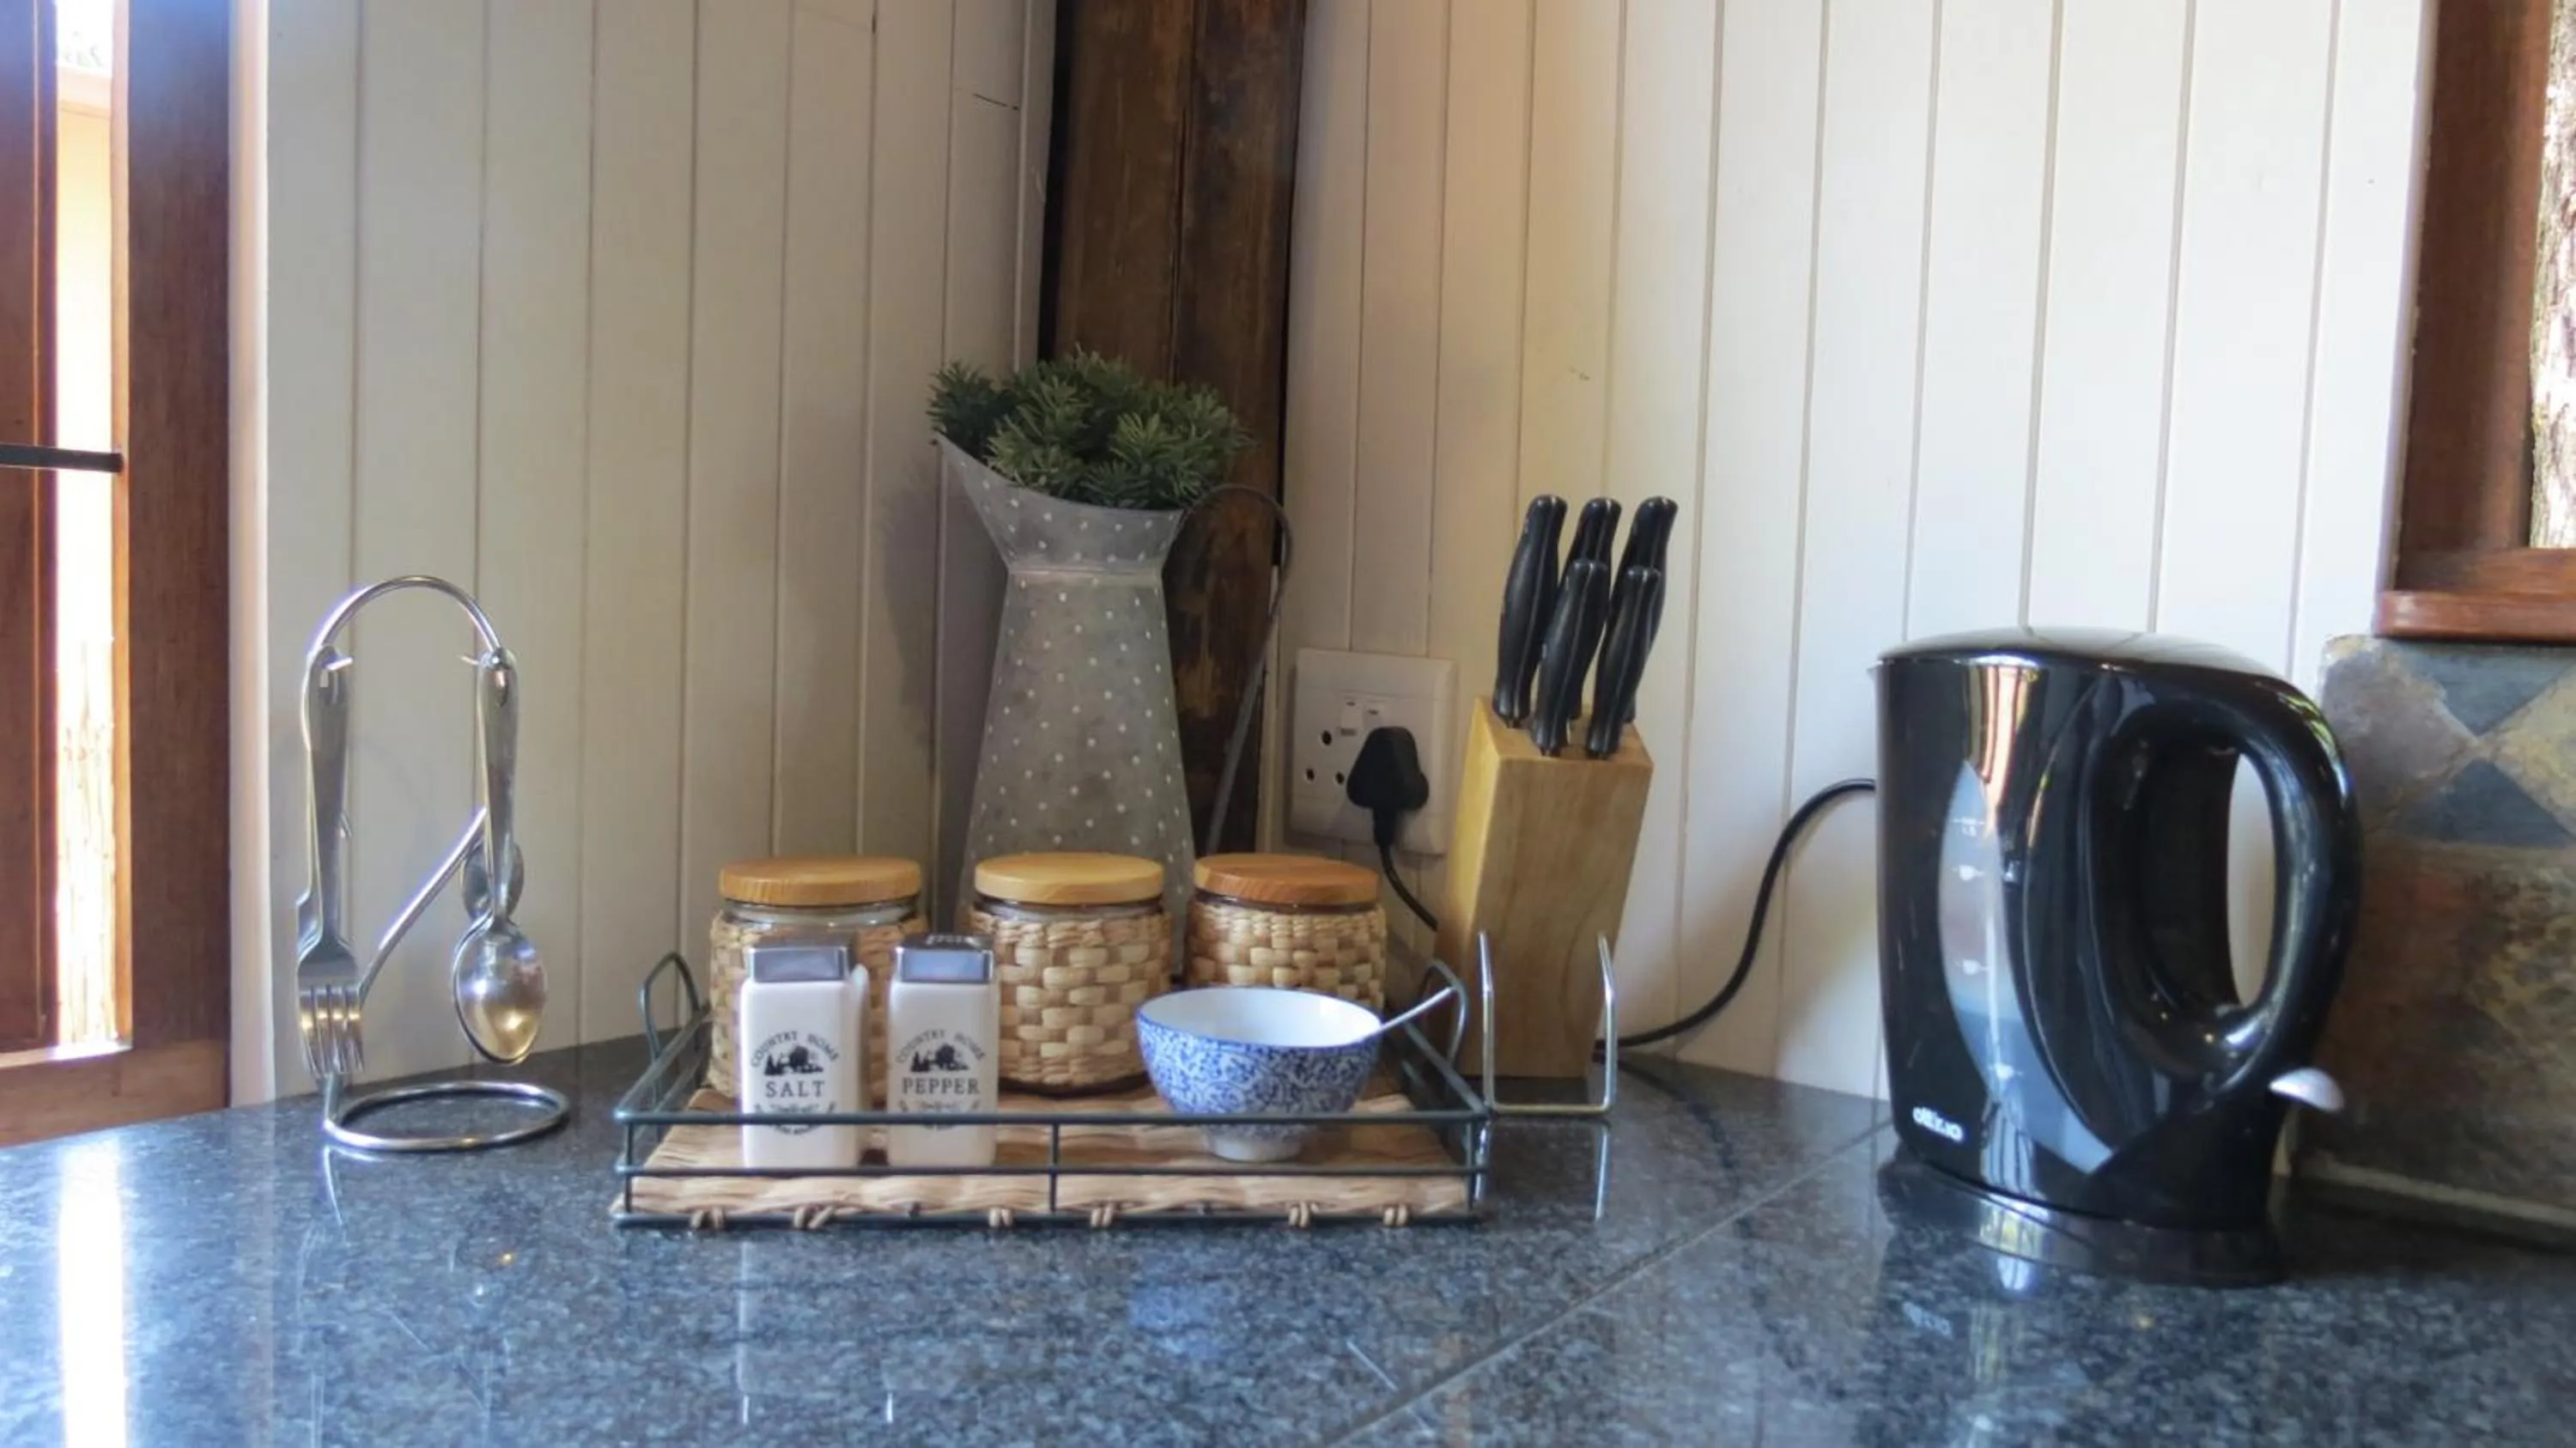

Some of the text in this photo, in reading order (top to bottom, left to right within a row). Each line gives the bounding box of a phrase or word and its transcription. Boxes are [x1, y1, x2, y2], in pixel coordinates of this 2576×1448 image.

[750, 1031, 798, 1068] COUNTRY
[895, 1029, 945, 1062] COUNTRY
[765, 1080, 825, 1098] SALT
[902, 1076, 981, 1095] PEPPER
